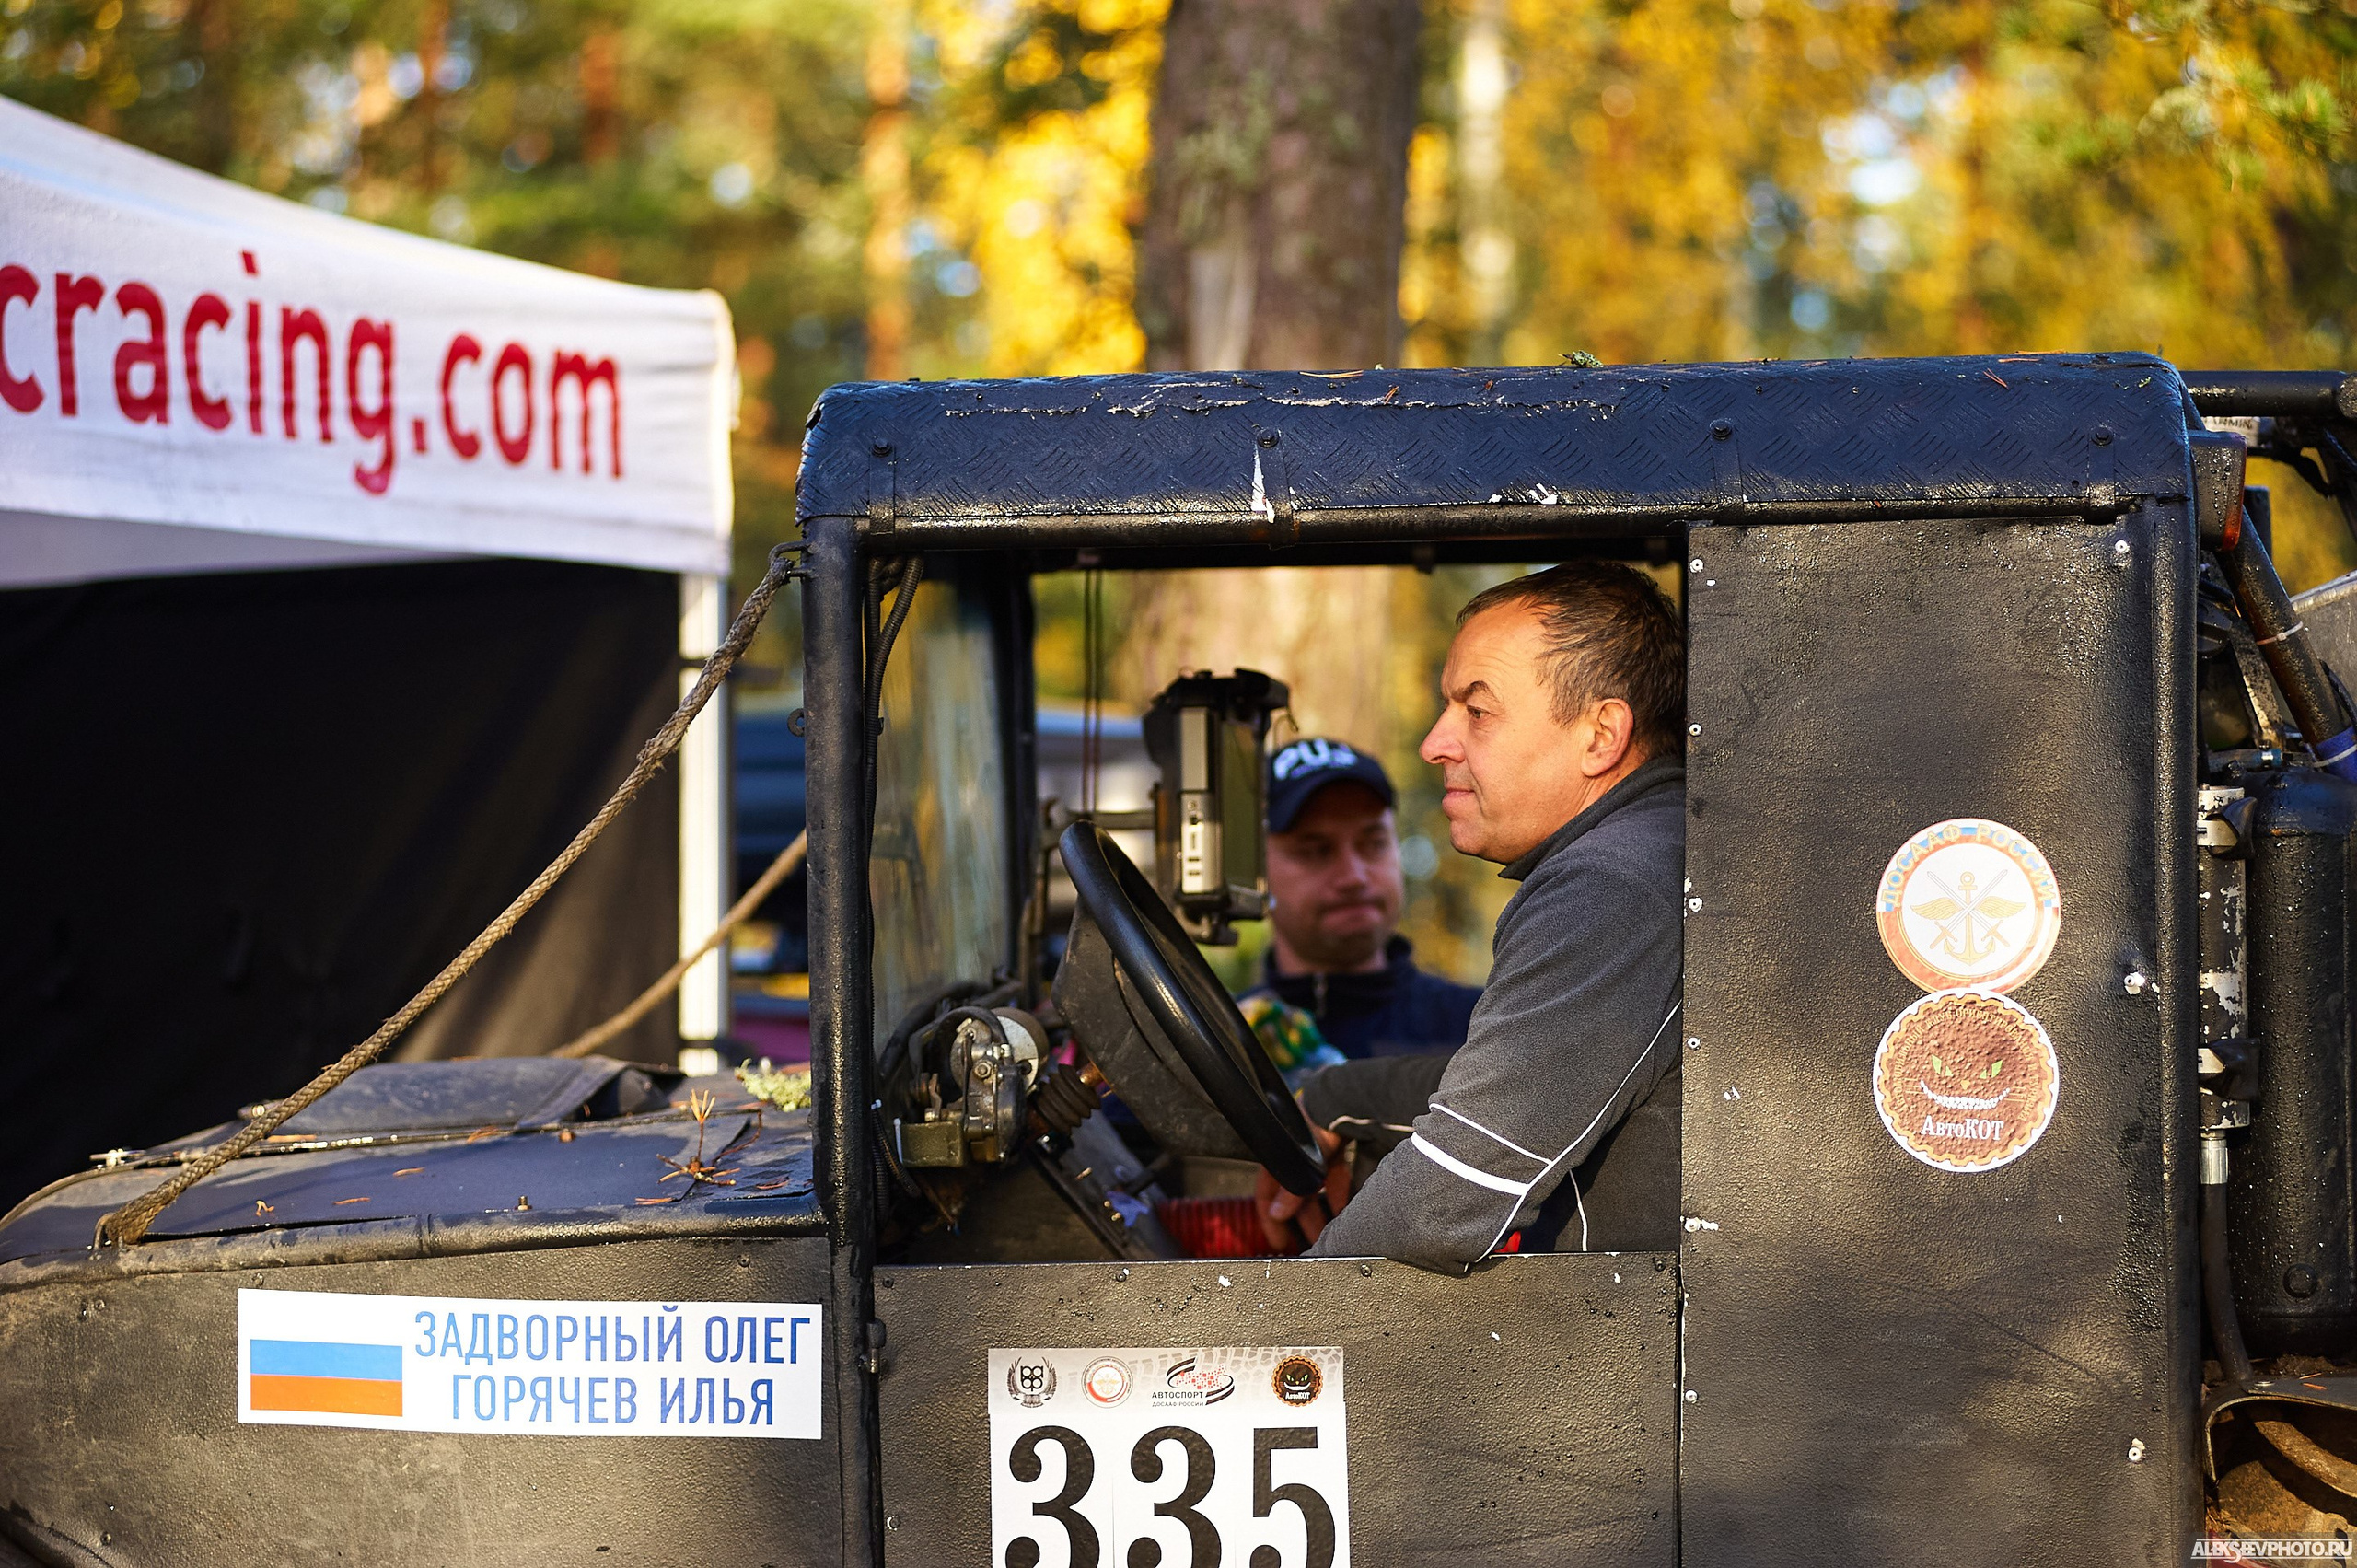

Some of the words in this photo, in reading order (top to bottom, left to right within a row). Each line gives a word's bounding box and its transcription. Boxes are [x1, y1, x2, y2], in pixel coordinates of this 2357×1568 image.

[0, 248, 624, 495] cracing.com
[1881, 824, 1961, 907] ДОСААФ
[1975, 823, 2056, 902] РОССИИ
[413, 1304, 683, 1366] ЗАДВОРНЫЙ
[704, 1315, 811, 1365] ОЛЕГ
[452, 1376, 637, 1423] ГОРЯЧЕВ
[660, 1377, 774, 1426] ИЛЬЯ
[1004, 1424, 1337, 1568] 335
